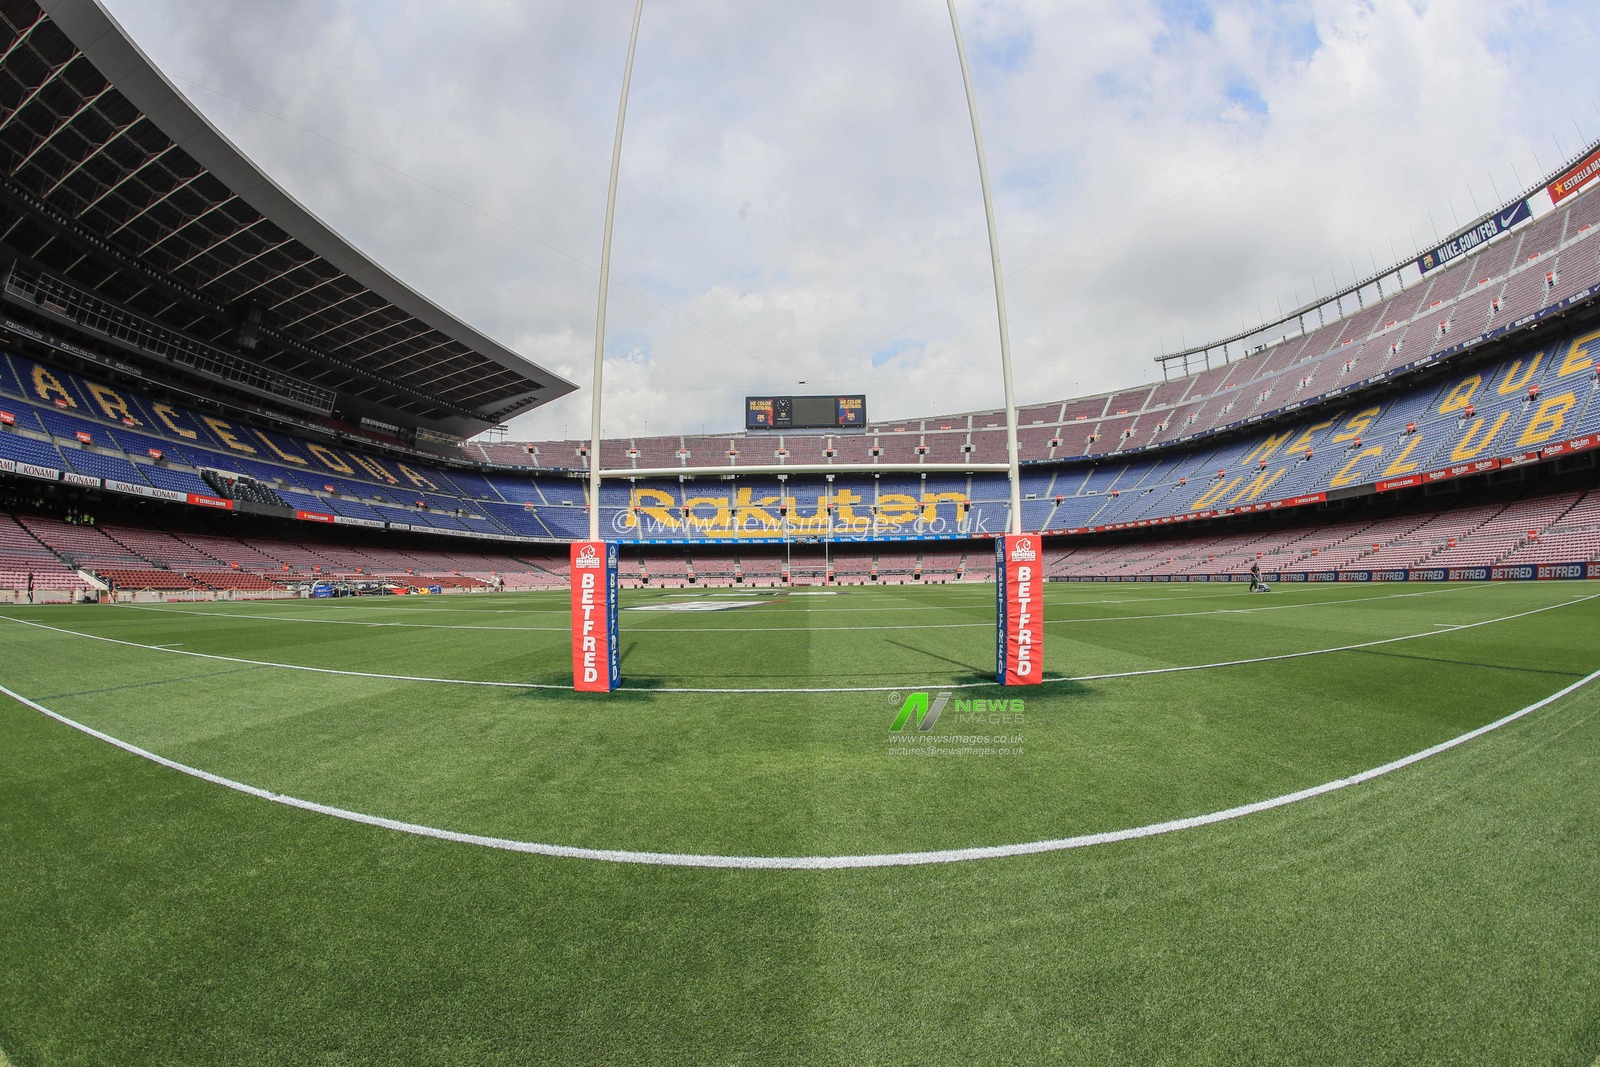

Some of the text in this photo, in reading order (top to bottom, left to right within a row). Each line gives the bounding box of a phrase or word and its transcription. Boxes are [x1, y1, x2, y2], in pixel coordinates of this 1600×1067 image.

[1563, 165, 1593, 191] ESTRELLA
[1437, 218, 1498, 263] NIKE.COM/FCB
[5, 320, 43, 340] FCBARCELONA.COM
[60, 342, 97, 360] FCBARCELONA.COM
[1438, 328, 1600, 415] QUE
[1544, 444, 1564, 456] Rakuten
[1570, 437, 1590, 450] Rakuten
[1190, 391, 1577, 511] UN CLUB
[23, 464, 55, 479] KONAMI
[1452, 465, 1469, 476] Rakuten
[1475, 460, 1493, 470] Rakuten
[67, 474, 98, 487] KONAMI
[1429, 470, 1446, 480] Rakuten
[115, 482, 144, 495] KONAMI
[152, 489, 179, 500] KONAMI
[625, 486, 968, 530] Rakuten
[1280, 572, 1304, 581] BETFRED
[1308, 571, 1335, 581] BETFRED
[1338, 571, 1368, 581] BETFRED
[1372, 570, 1404, 581] BETFRED
[1408, 570, 1444, 580] BETFRED
[1450, 568, 1486, 580] BETFRED
[1491, 567, 1532, 579] BETFRED
[1537, 566, 1581, 578] BETFRED
[610, 573, 618, 681] BETFRED
[1017, 566, 1032, 676] BETFRED
[581, 573, 598, 683] BETFRED
